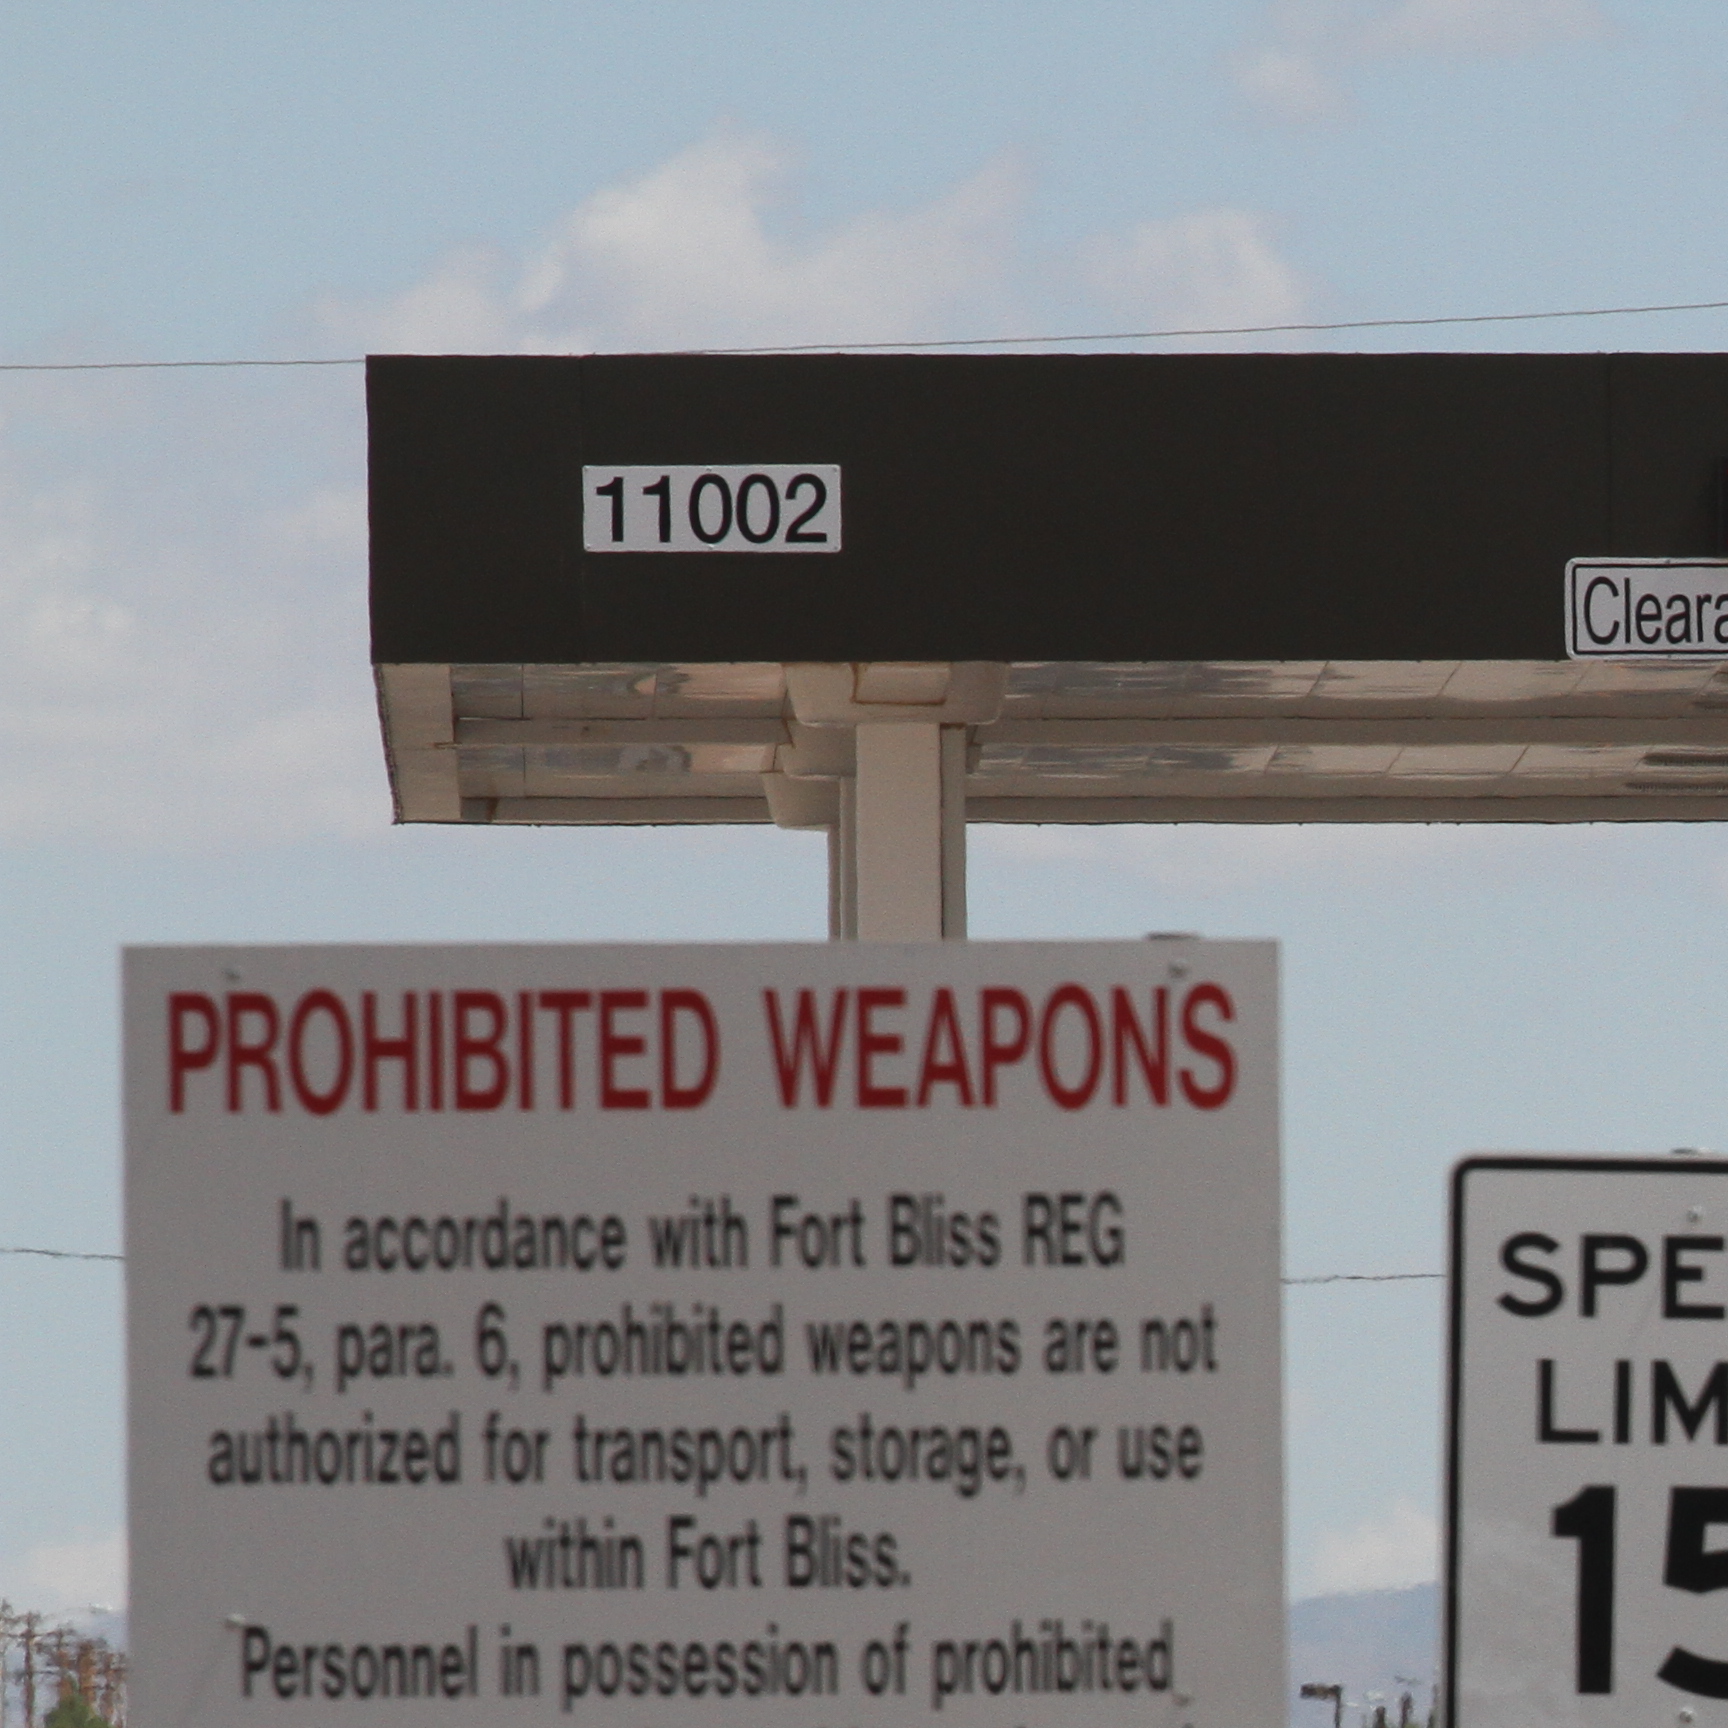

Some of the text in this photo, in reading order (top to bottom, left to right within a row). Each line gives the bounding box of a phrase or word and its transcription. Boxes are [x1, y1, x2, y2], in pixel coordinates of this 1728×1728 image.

[596, 473, 828, 544] 11002
[166, 981, 1238, 1116] PROHIBITED WEAPONS
[280, 1190, 1125, 1274] In accordance with Fort Bliss REG
[188, 1302, 1217, 1393] 27-5, para. 6, prohibited weapons are not
[207, 1410, 1203, 1500] authorized for transport, storage, or use
[504, 1513, 911, 1591] within Fort Bliss.
[239, 1619, 1173, 1713] Personnel in possession of prohibited
